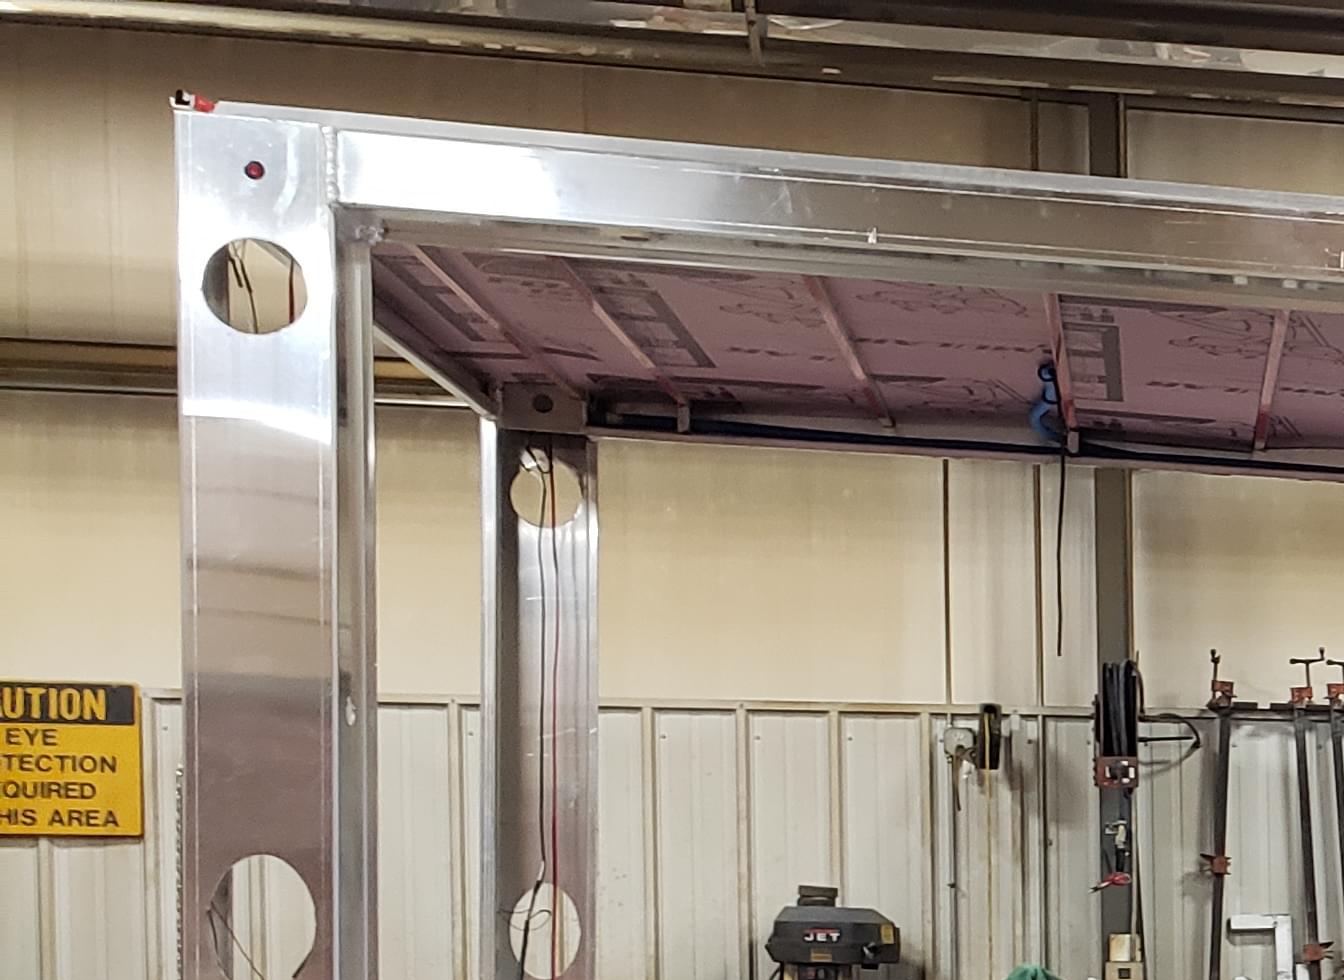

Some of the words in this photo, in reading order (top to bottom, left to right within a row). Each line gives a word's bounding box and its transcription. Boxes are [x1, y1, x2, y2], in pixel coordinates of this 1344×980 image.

[0, 687, 107, 721] UTION
[5, 728, 58, 746] EYE
[0, 754, 117, 773] TECTION
[2, 781, 96, 799] QUIRED
[0, 809, 37, 826] HIS
[48, 809, 119, 827] AREA
[803, 932, 840, 942] JET
